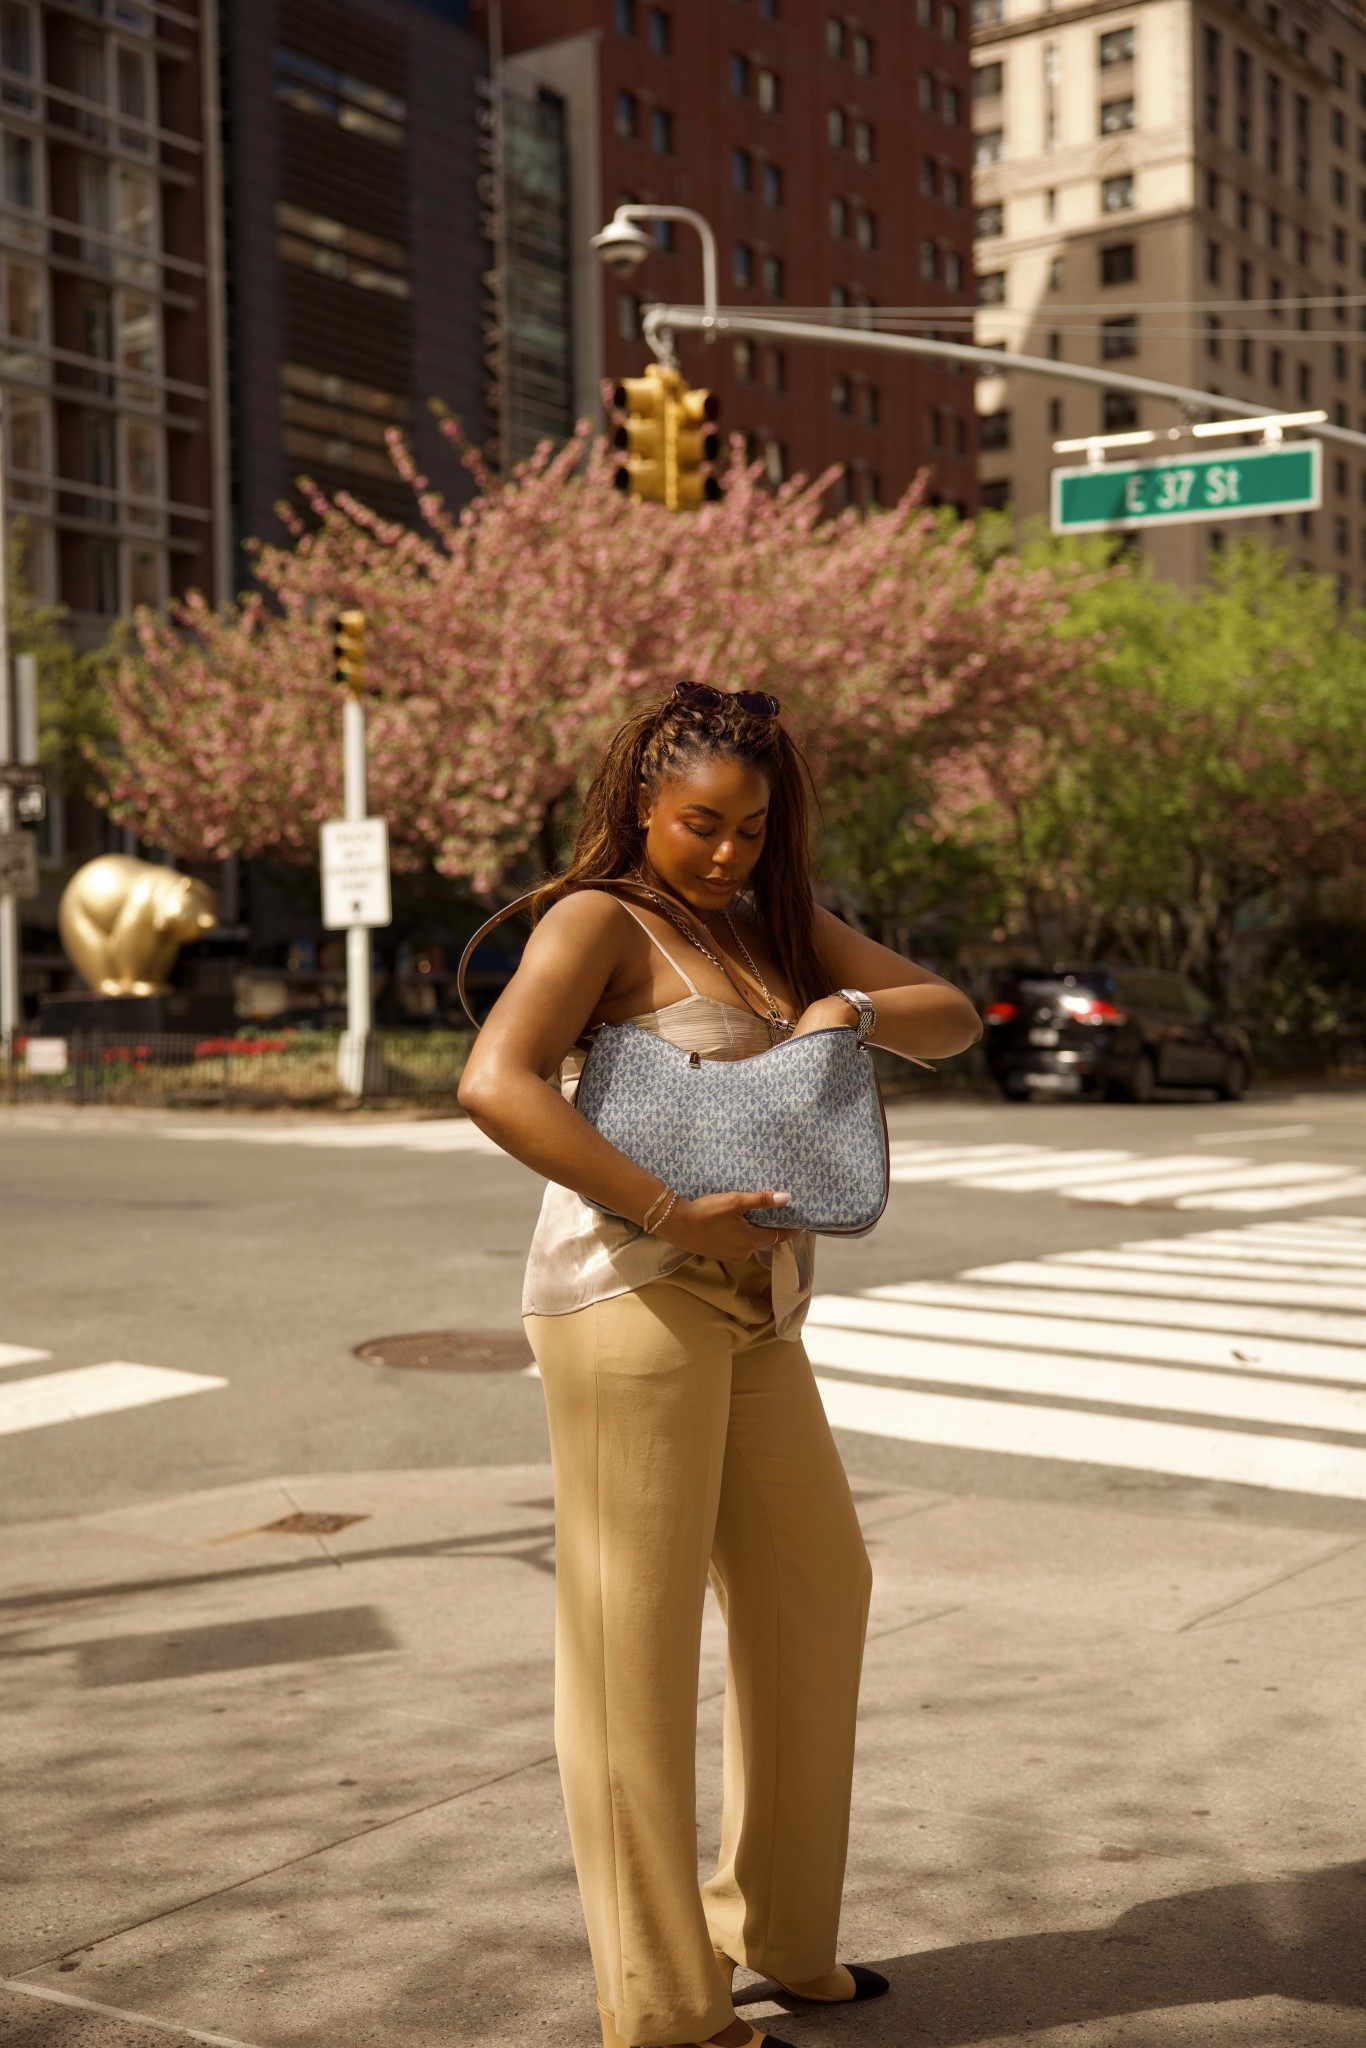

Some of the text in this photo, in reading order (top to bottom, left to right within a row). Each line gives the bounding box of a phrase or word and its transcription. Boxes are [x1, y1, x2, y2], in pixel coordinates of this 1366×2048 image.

[1126, 466, 1239, 512] E 37 St
